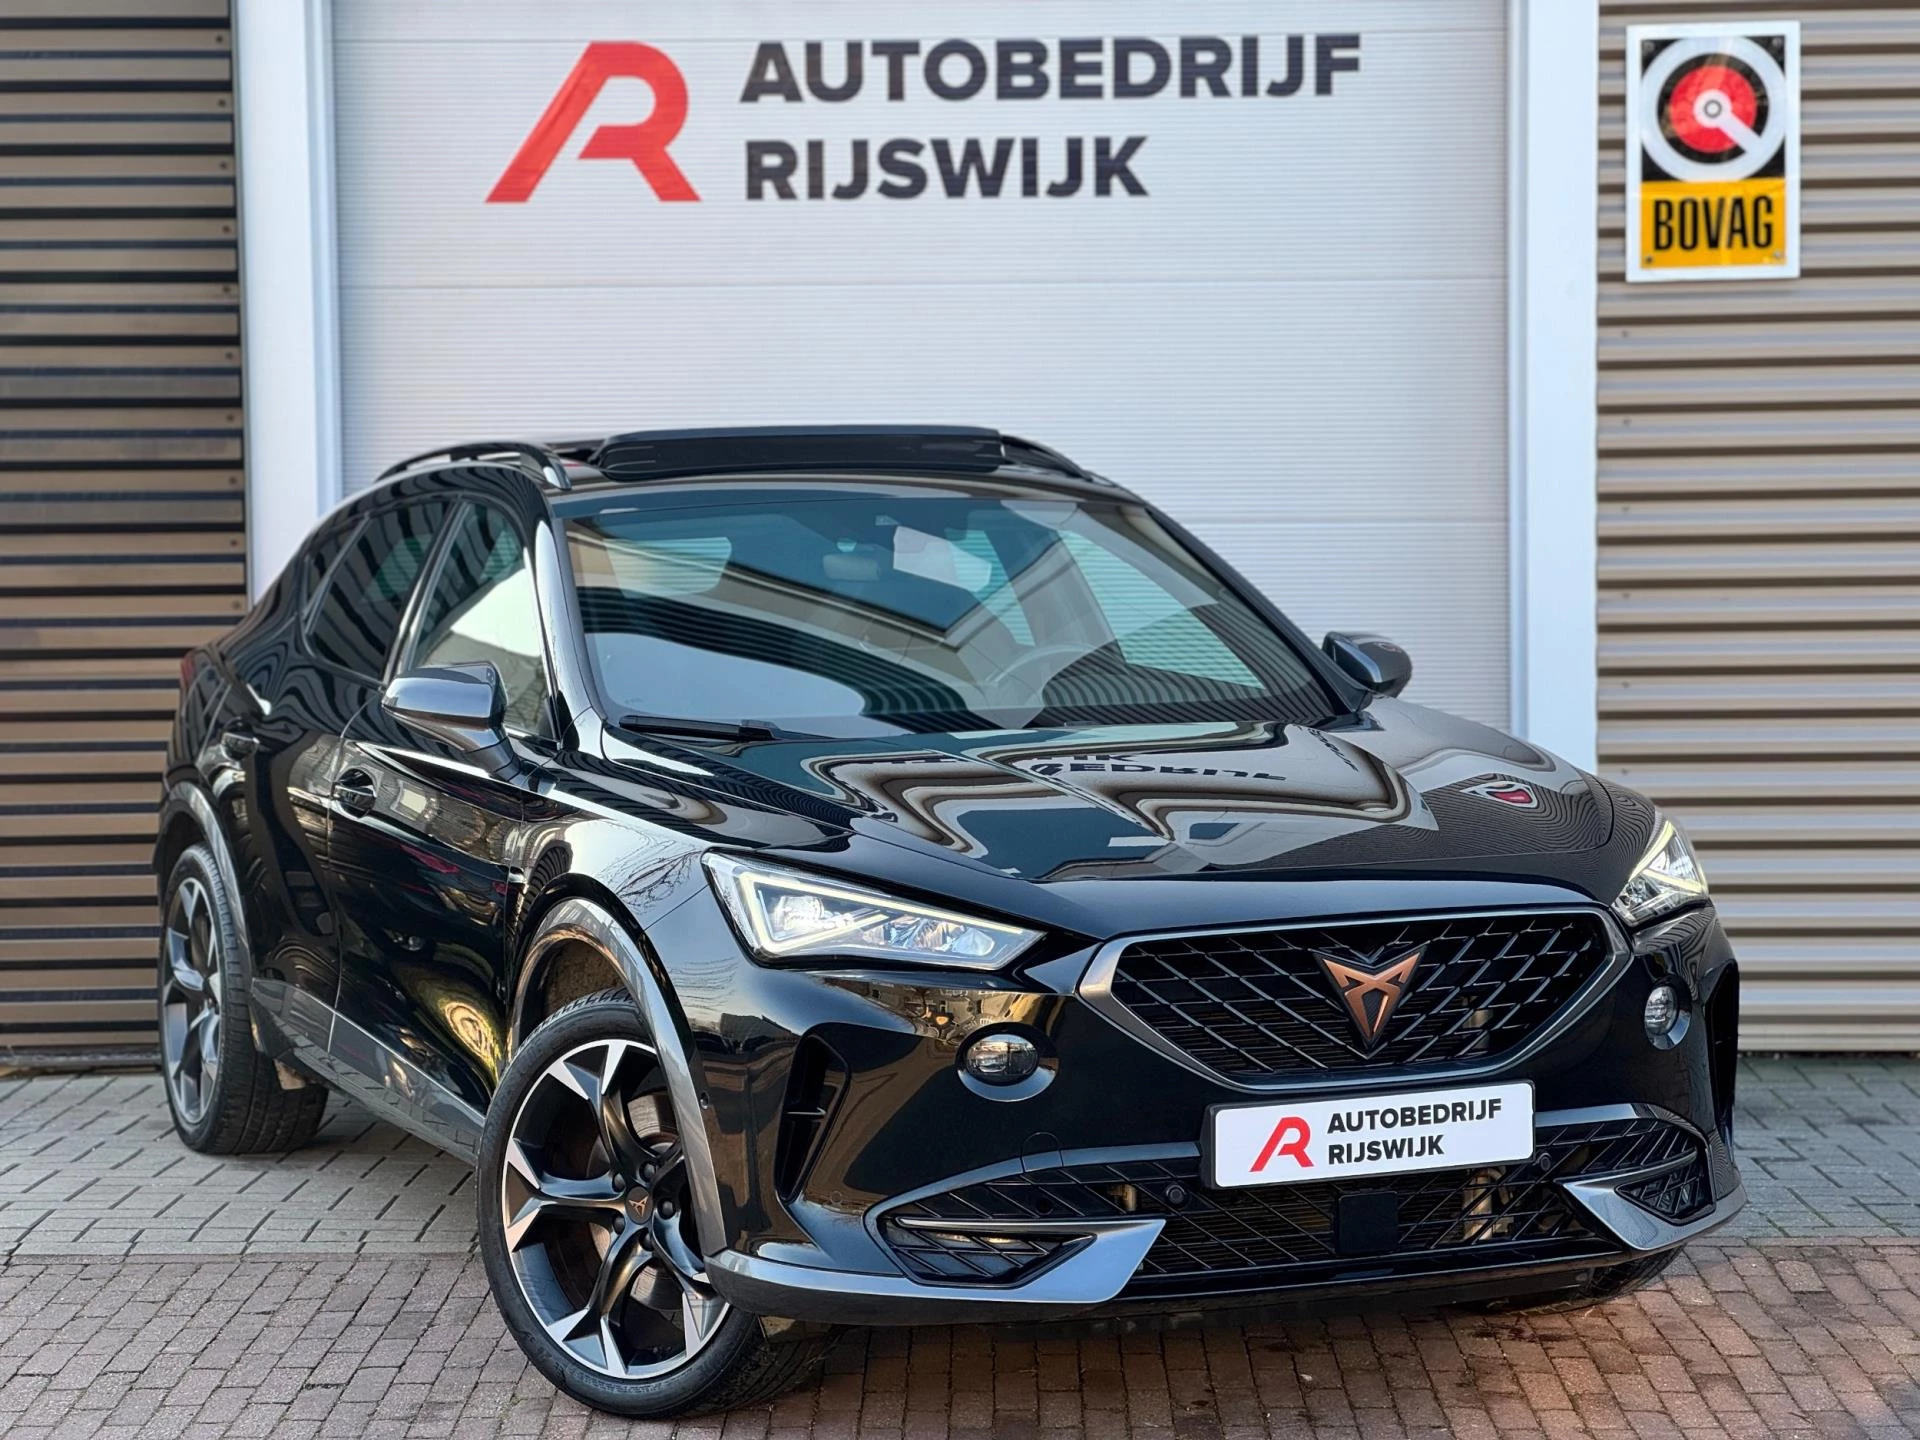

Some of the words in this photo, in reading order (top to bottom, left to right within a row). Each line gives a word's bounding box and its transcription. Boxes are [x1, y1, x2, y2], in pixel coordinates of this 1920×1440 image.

[741, 34, 1361, 103] AUTOBEDRIJF
[746, 136, 1148, 200] RIJSWIJK
[1654, 195, 1773, 251] BOVAG
[1327, 1098, 1502, 1134] AUTOBEDRIJF
[1328, 1135, 1444, 1165] RIJSWIJK
